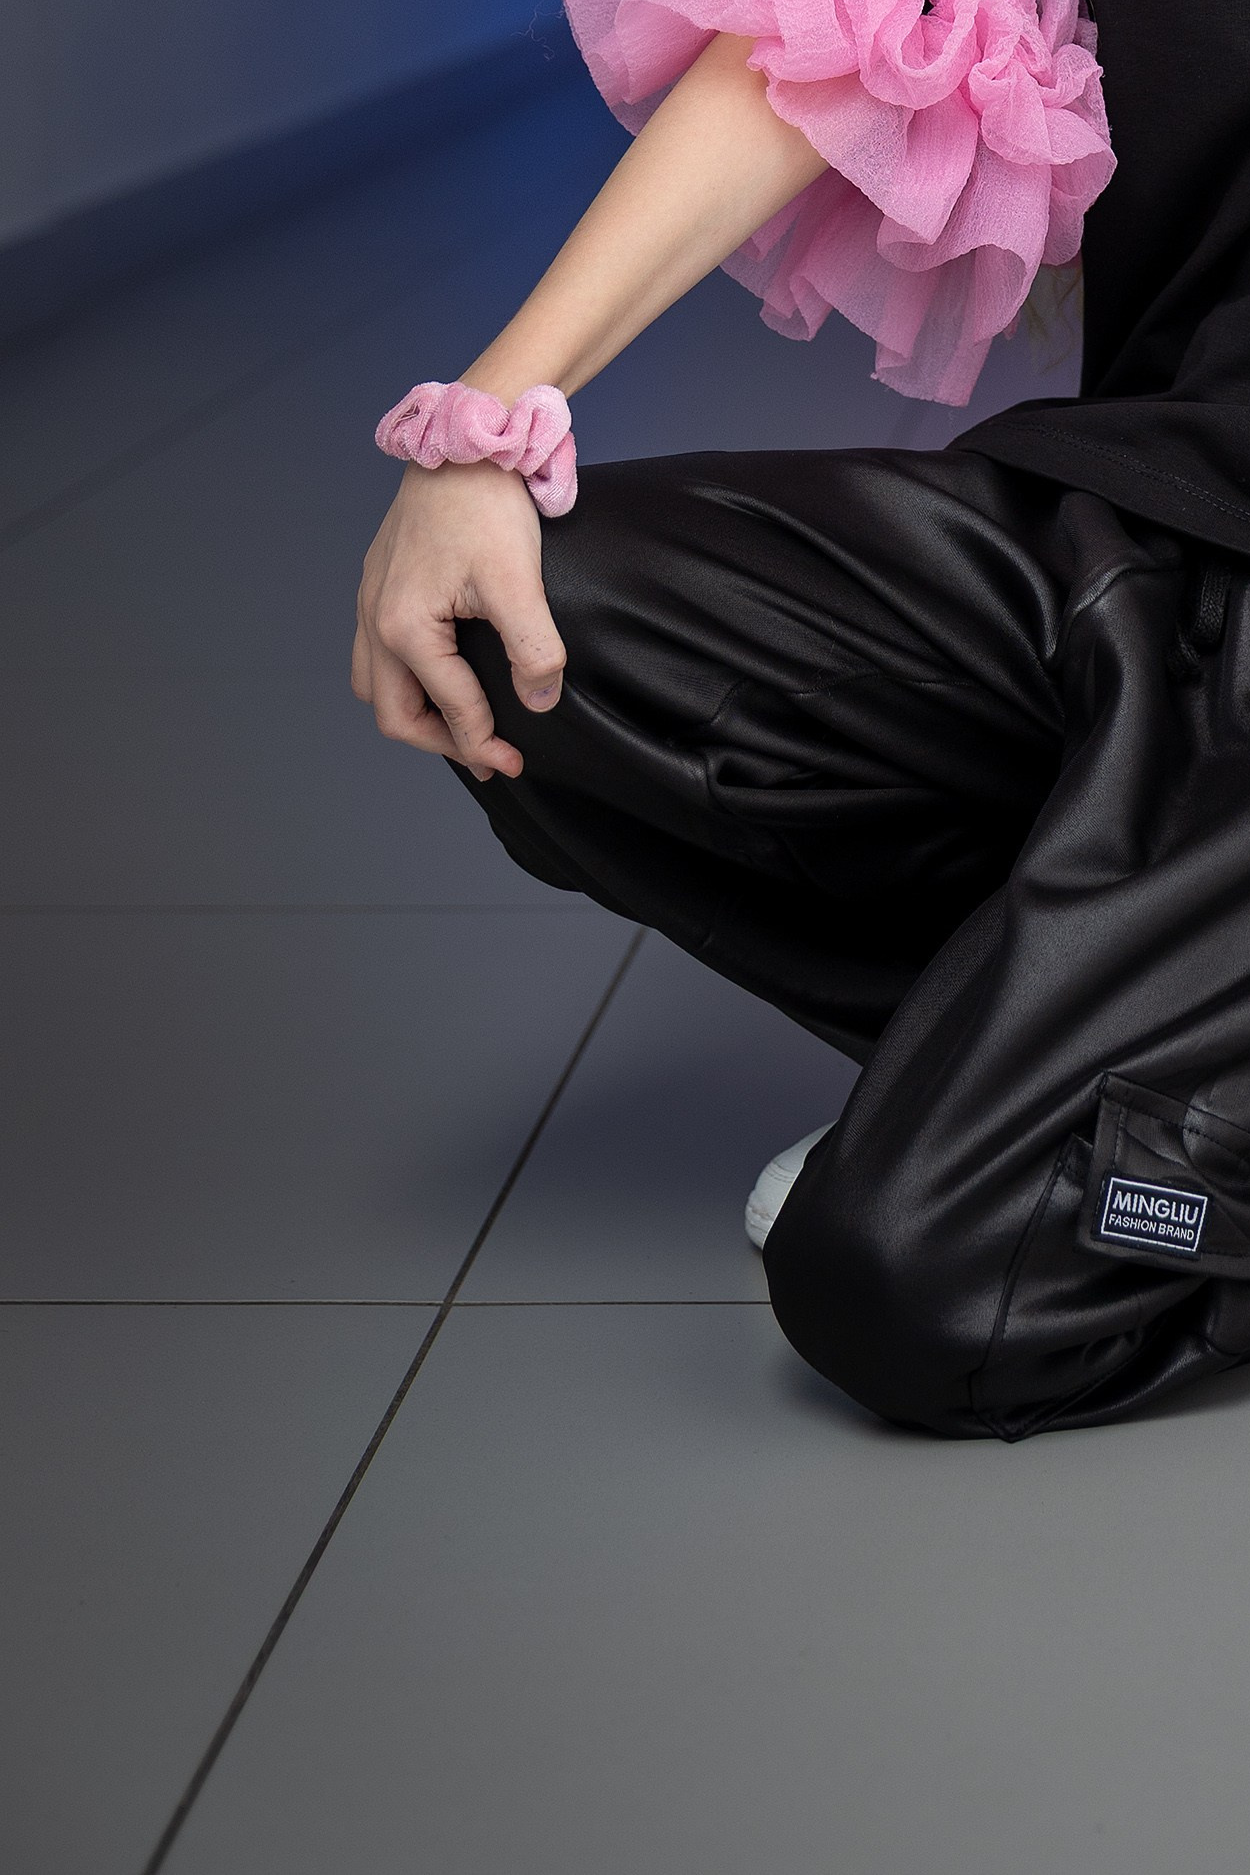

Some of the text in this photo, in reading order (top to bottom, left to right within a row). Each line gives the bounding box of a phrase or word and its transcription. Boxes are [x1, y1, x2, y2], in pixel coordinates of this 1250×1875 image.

[1112, 1190, 1199, 1224] MINGLIU
[1108, 1213, 1195, 1240] FASHION BRAND
